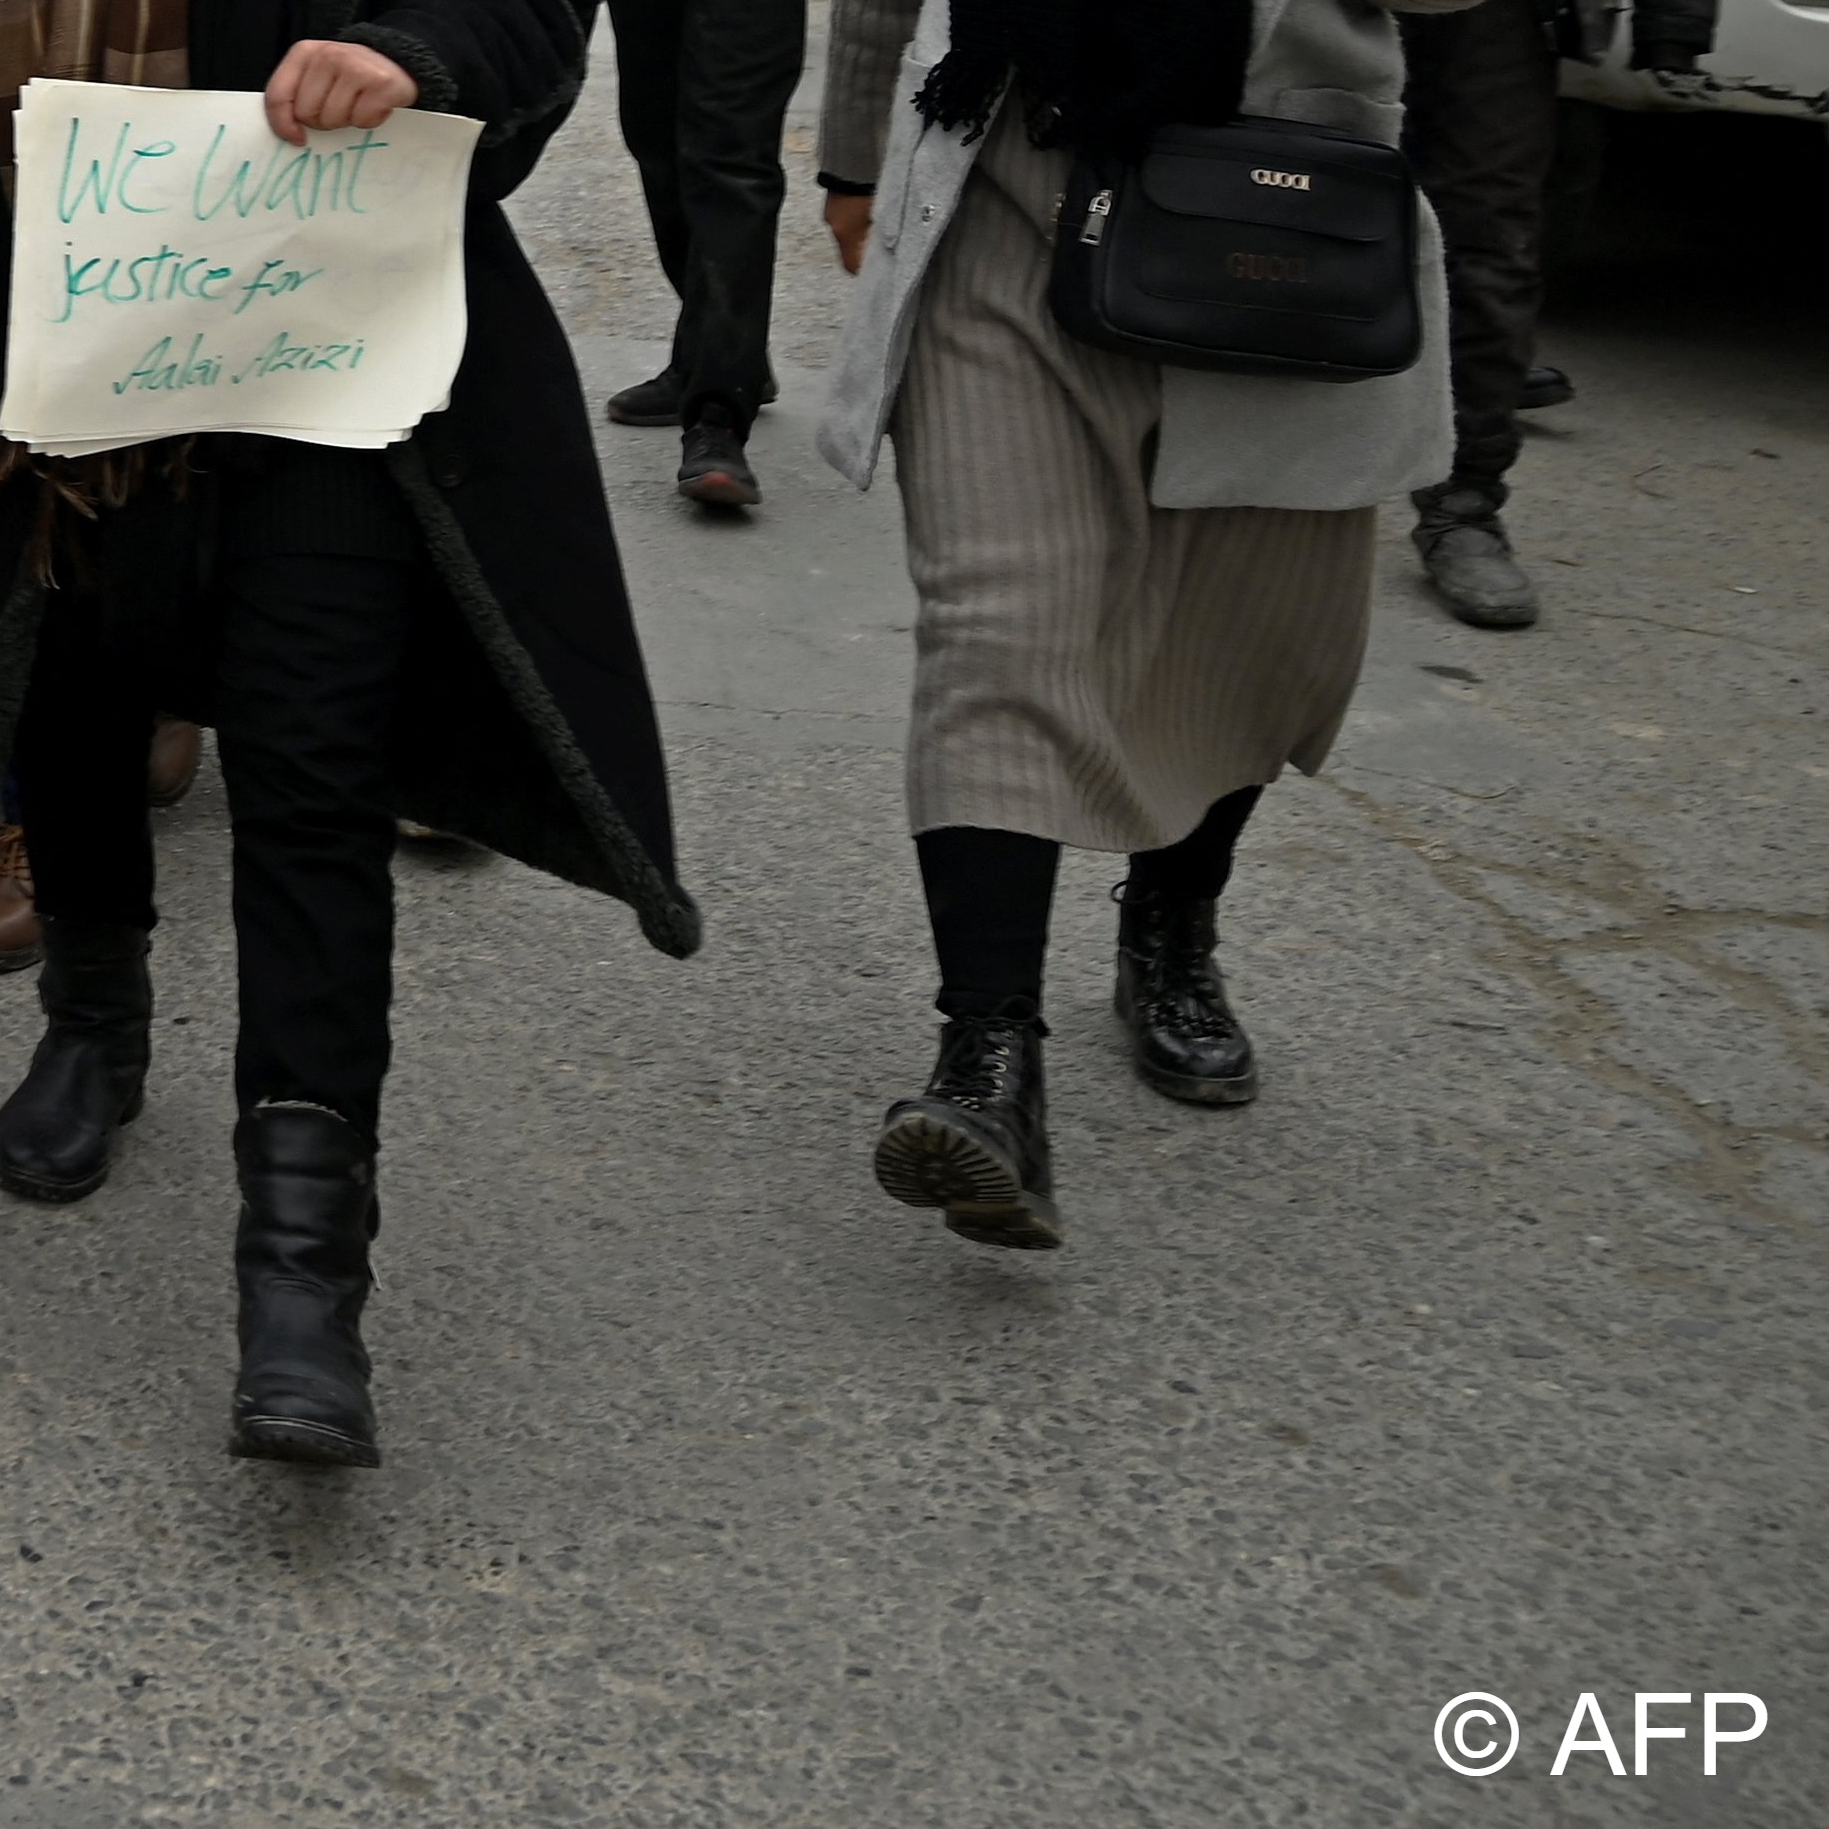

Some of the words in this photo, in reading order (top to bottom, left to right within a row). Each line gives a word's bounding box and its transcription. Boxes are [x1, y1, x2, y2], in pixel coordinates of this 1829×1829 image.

[57, 116, 177, 223] We
[194, 121, 390, 220] Want
[43, 241, 233, 323] justice
[232, 259, 327, 314] for
